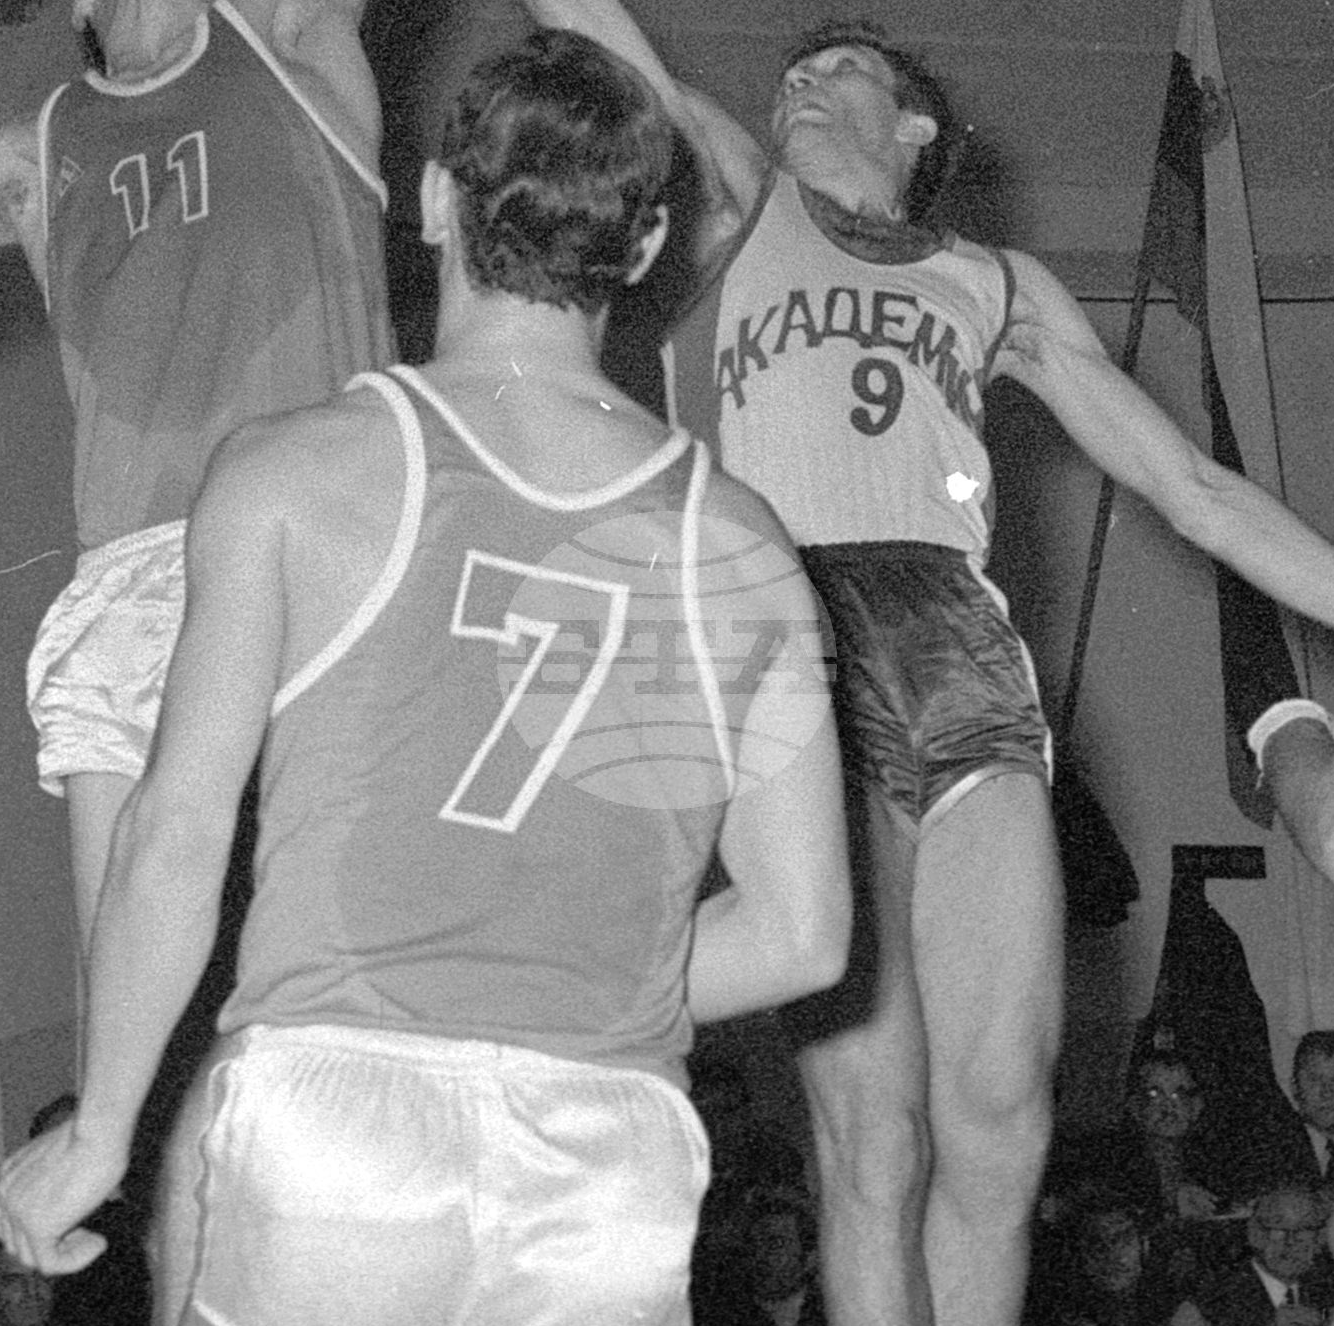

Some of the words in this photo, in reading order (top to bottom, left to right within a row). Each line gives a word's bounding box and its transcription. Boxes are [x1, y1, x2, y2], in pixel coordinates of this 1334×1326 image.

[109, 130, 209, 240] 11
[850, 357, 905, 437] 9
[438, 549, 630, 833] 7
